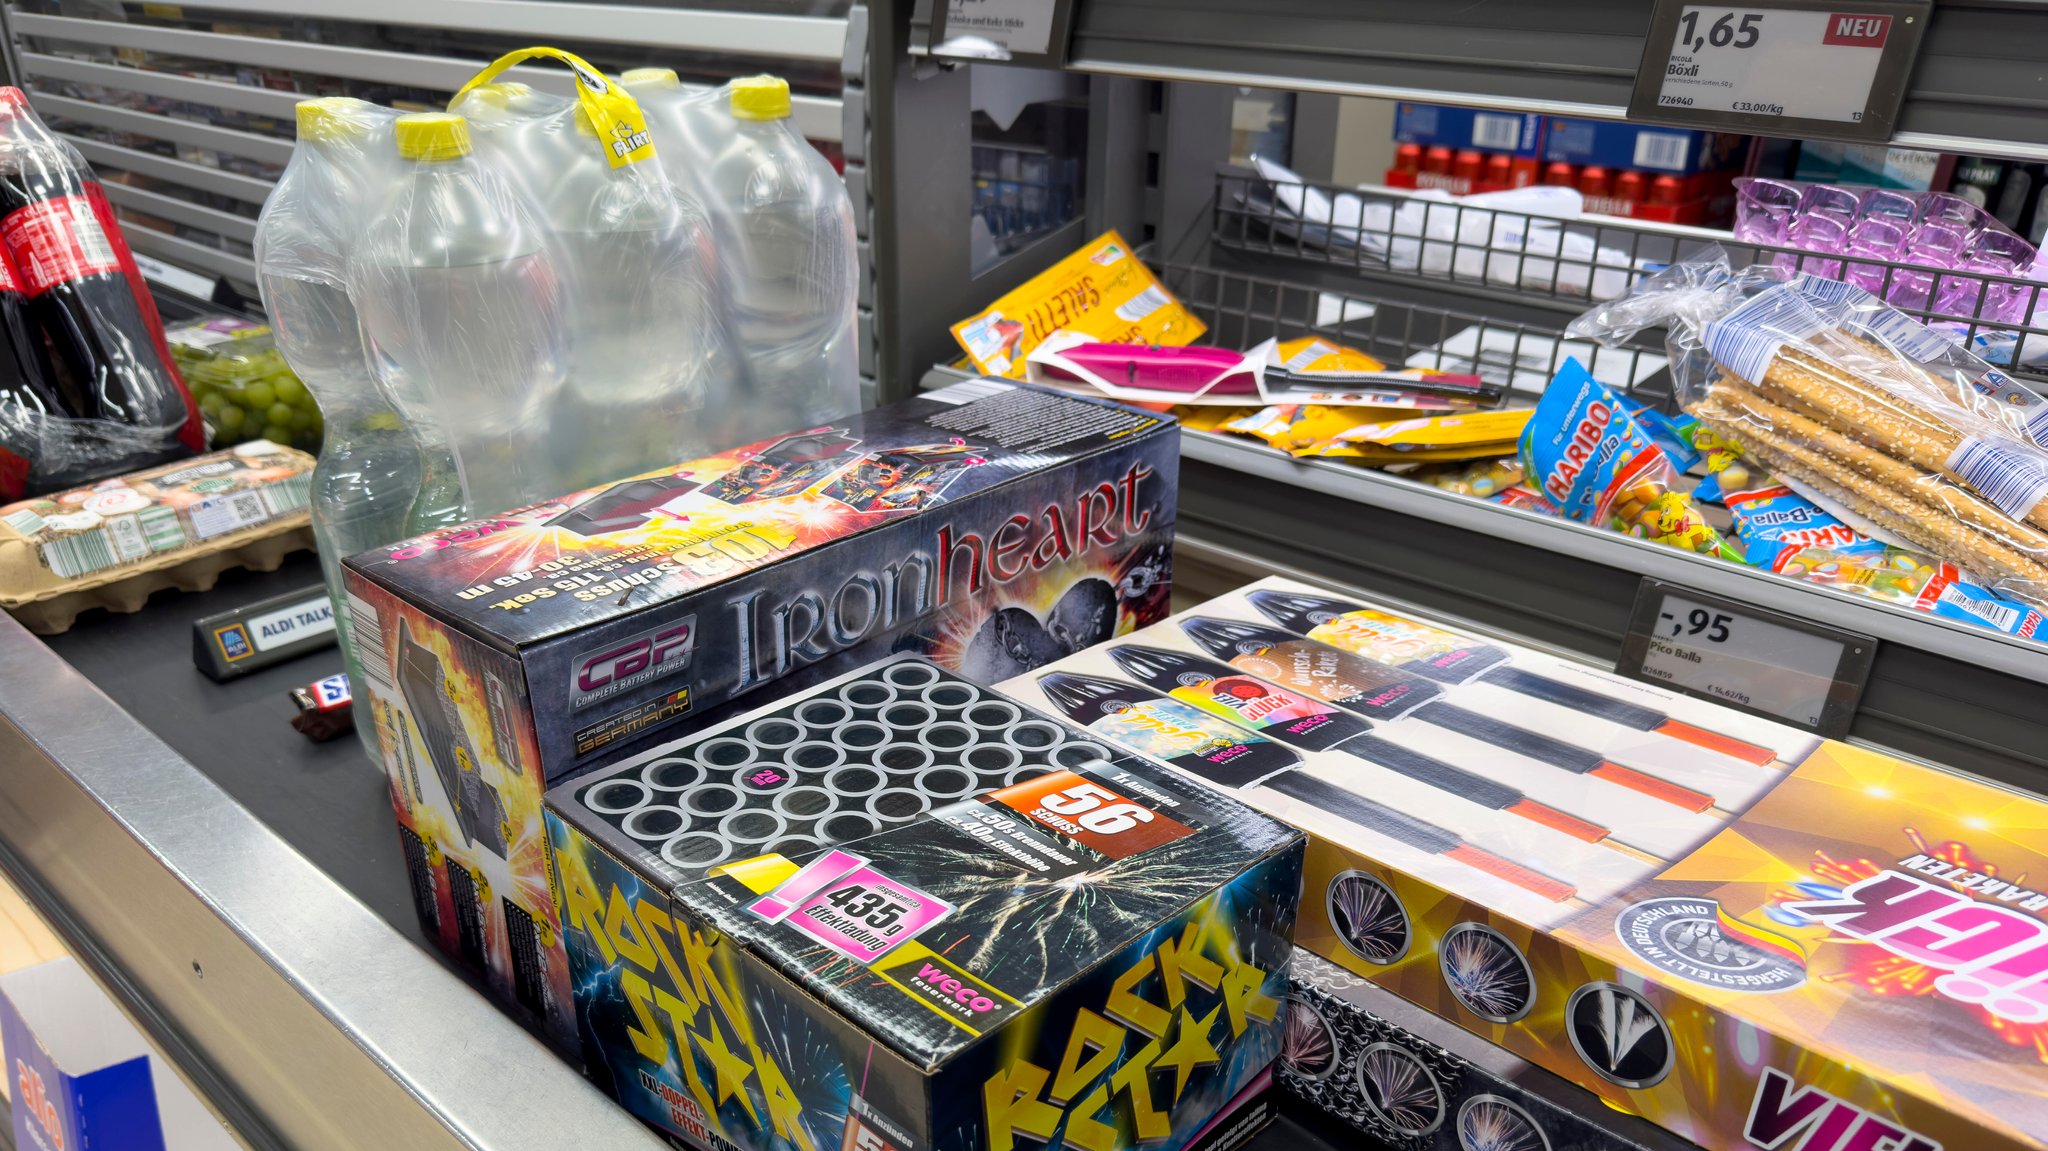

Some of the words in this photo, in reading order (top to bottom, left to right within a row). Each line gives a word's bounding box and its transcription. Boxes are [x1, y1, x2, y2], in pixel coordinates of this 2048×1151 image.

[1681, 10, 1764, 54] 1,65
[1836, 18, 1882, 38] NEU
[1667, 63, 1699, 78] Böxli
[1671, 55, 1693, 63] RICOLA
[1660, 95, 1694, 106] 726940
[1732, 101, 1738, 110] €
[1739, 102, 1784, 116] 33,00/kg
[1852, 112, 1862, 121] 13
[611, 129, 651, 159] FLIRT
[1025, 274, 1101, 343] SALETTI
[1561, 380, 1591, 432] unterwegs
[1544, 399, 1612, 502] HARIBO
[390, 519, 525, 561] weco
[671, 524, 797, 577] 103
[492, 554, 583, 589] 30-45
[554, 571, 603, 593] 115
[456, 584, 496, 601] m
[488, 587, 557, 611] Sek.
[262, 618, 294, 639] ALDI
[297, 605, 333, 628] TALK
[2016, 609, 2042, 640] HARI
[577, 623, 690, 692] CBP
[1431, 650, 1470, 669] weco
[1650, 641, 1673, 656] Pico
[1675, 648, 1702, 664] Balla
[575, 684, 619, 708] COMPLETE
[620, 669, 655, 691] BATTERY
[656, 657, 686, 676] POWER
[1366, 684, 1410, 708] weco
[1714, 685, 1750, 705] 14,62/kg
[576, 708, 642, 742] CREATED
[644, 702, 657, 713] IN
[1239, 692, 1294, 722] GLÜCK
[1287, 713, 1329, 735] weco
[1809, 715, 1818, 725] 13
[576, 698, 690, 755] GERMANY
[1206, 743, 1249, 764] weco
[755, 769, 782, 785] 20
[1111, 772, 1128, 785] 1x
[1127, 781, 1181, 808] Anzünden
[1028, 807, 1085, 835] SCHUSS
[1039, 783, 1156, 836] 56
[944, 815, 962, 828] ca.
[992, 838, 1051, 872] Effekthöhe
[967, 808, 983, 821] ca.
[1010, 830, 1079, 867] Brenndauer
[1897, 854, 2048, 912] RAKETEN
[803, 904, 889, 952] Effektladung
[825, 884, 908, 930] 435
[885, 925, 905, 938] g
[1630, 903, 1709, 945] DEUTSCHLAND
[555, 846, 751, 1046] ROCK
[1642, 945, 1657, 957] IN
[916, 960, 996, 1014] weco
[1661, 958, 1792, 988] HERGESTELLT
[909, 974, 976, 1019] feuerwerk
[984, 921, 1226, 1151] ROCK
[861, 1101, 873, 1120] 1x
[872, 1112, 915, 1149] Anzünden
